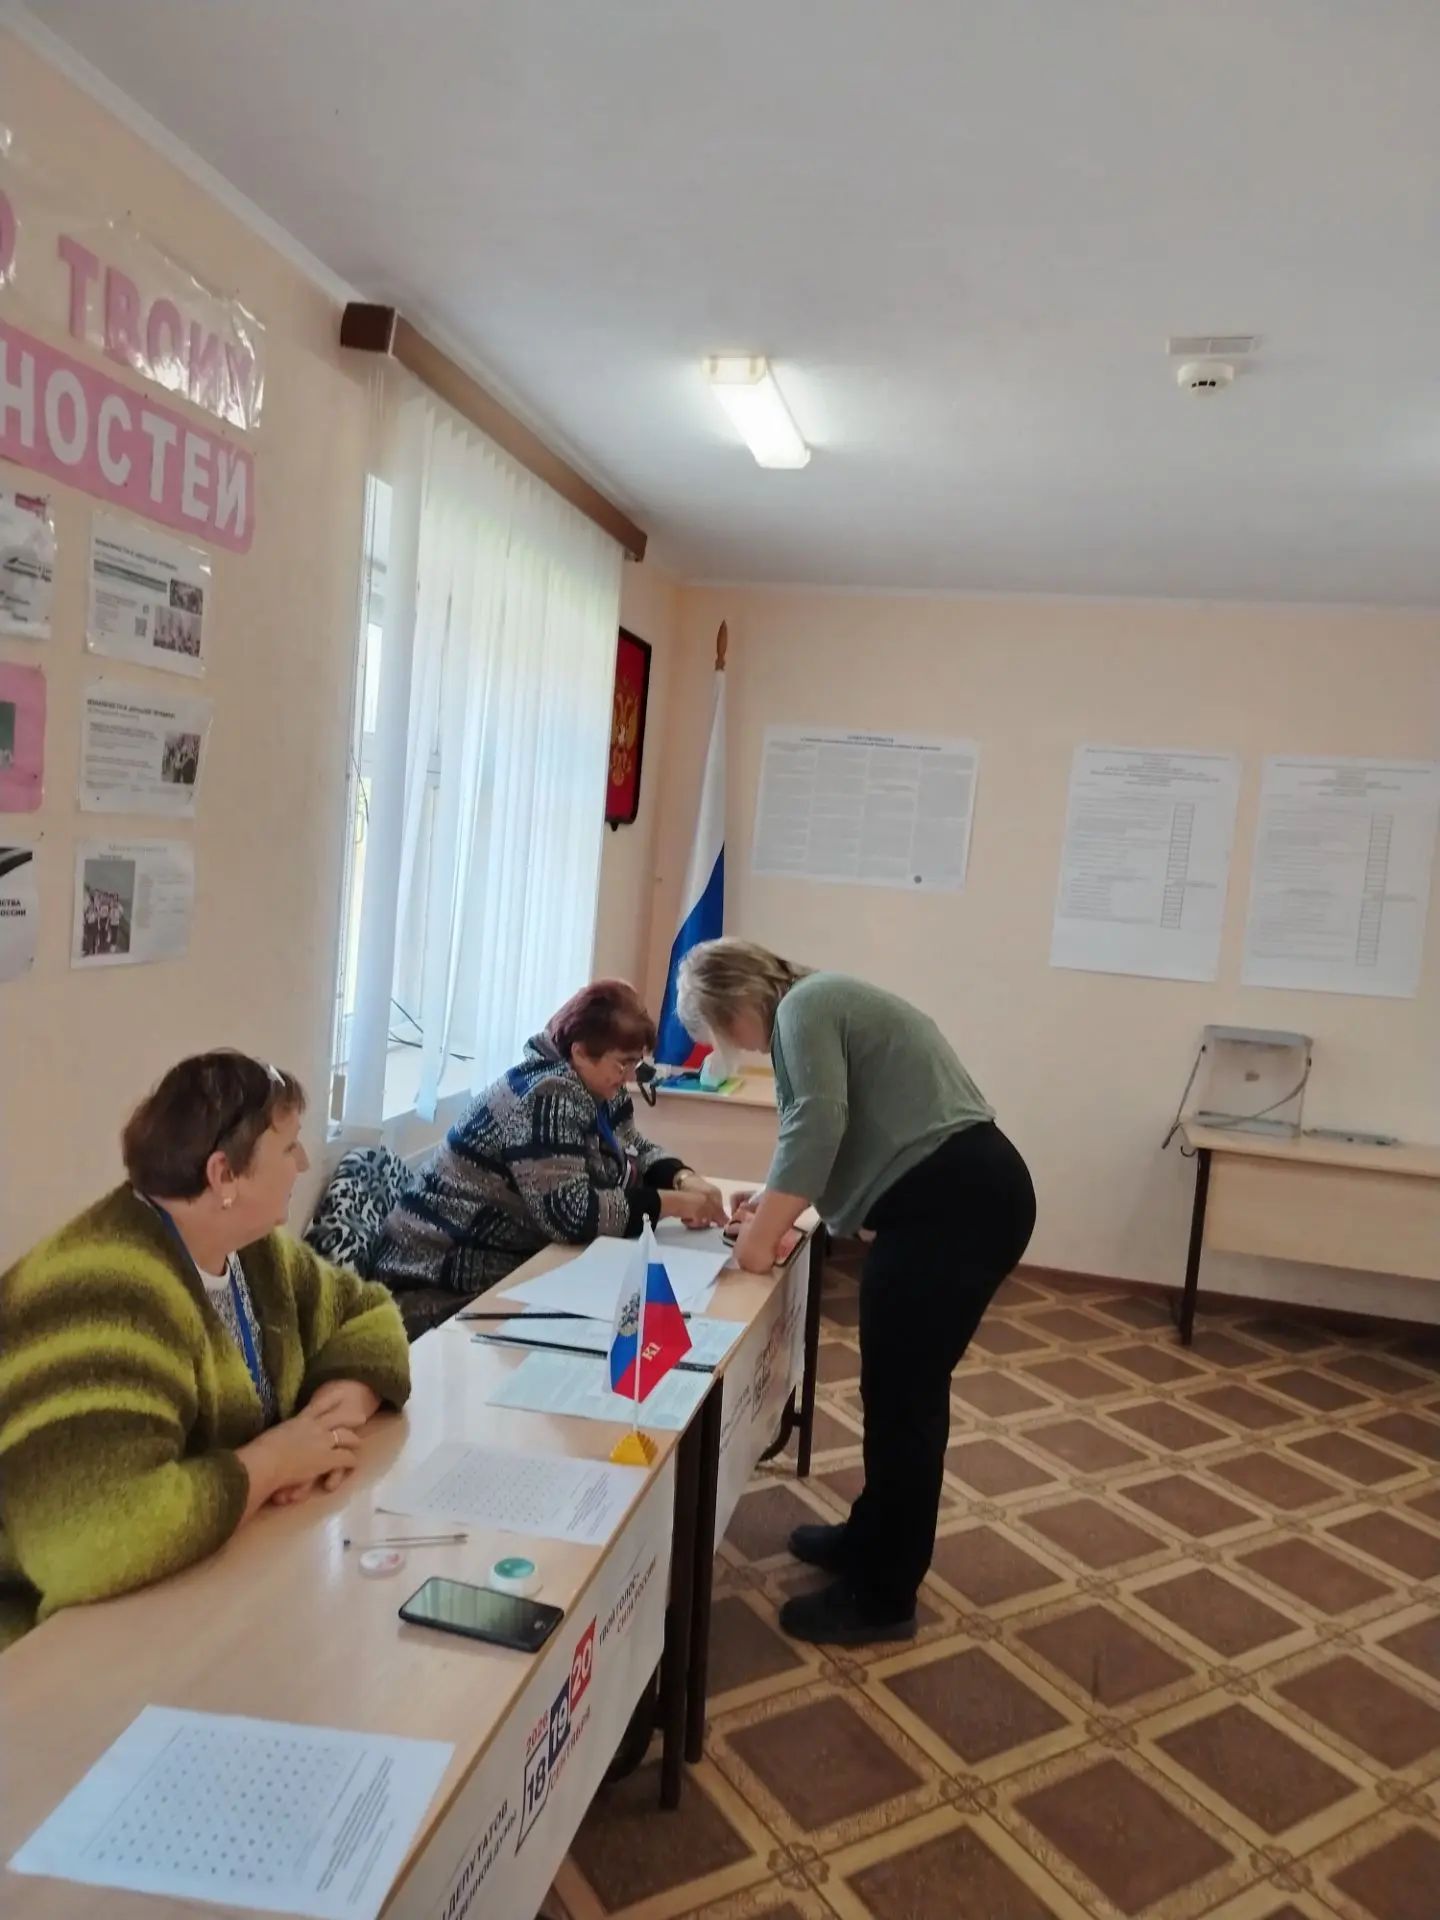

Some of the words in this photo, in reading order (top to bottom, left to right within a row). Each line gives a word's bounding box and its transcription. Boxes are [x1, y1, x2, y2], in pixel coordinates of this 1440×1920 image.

[527, 1755, 546, 1813] 18
[551, 1694, 569, 1752] 19
[571, 1637, 593, 1699] 20
[447, 1797, 508, 1920] ДЕПУТАТОВ
